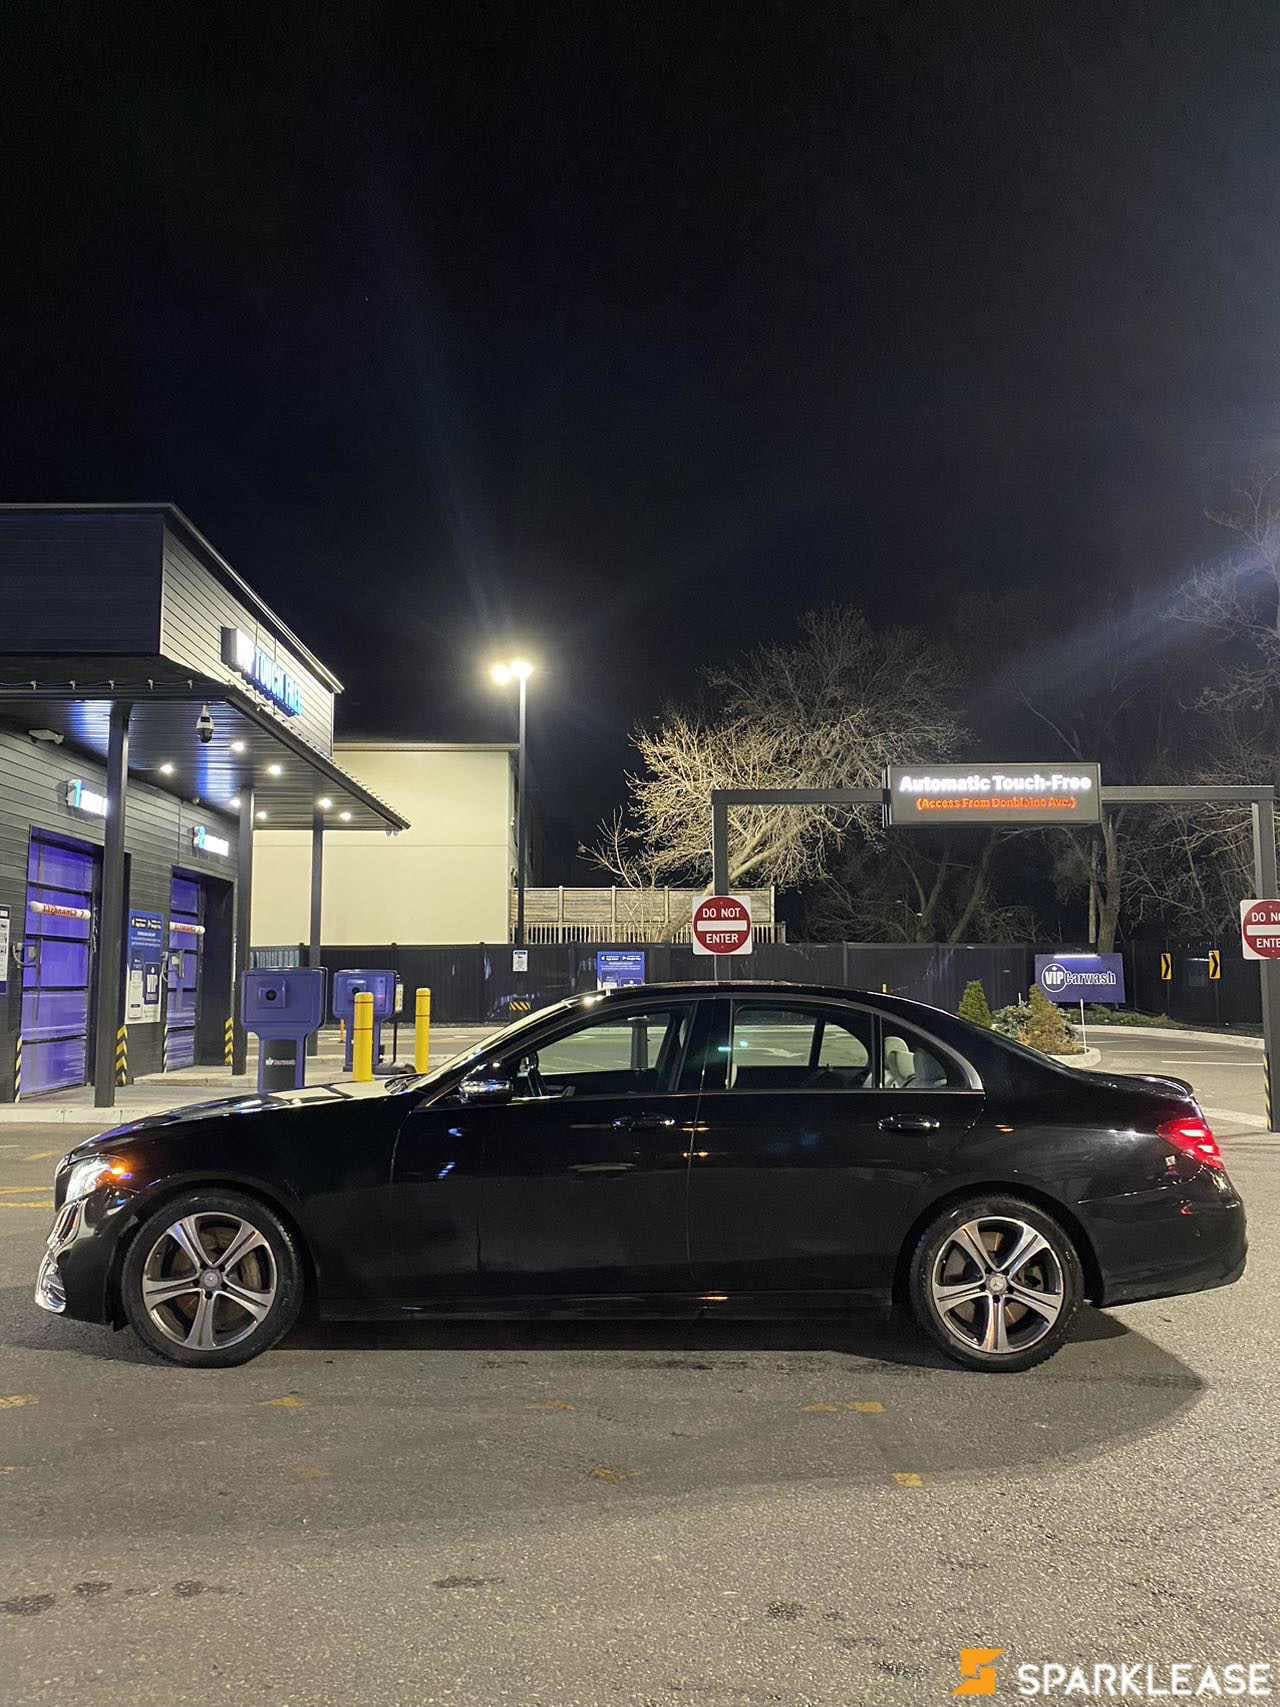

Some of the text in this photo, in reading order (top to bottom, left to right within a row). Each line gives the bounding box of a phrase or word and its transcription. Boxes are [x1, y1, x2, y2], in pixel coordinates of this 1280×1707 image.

[899, 774, 1092, 792] Automatic Touch-Free
[962, 798, 989, 809] From
[702, 907, 741, 918] DO NOT
[1251, 911, 1266, 922] DO
[705, 933, 739, 944] ENTER
[1044, 970, 1117, 985] VIP Carwash
